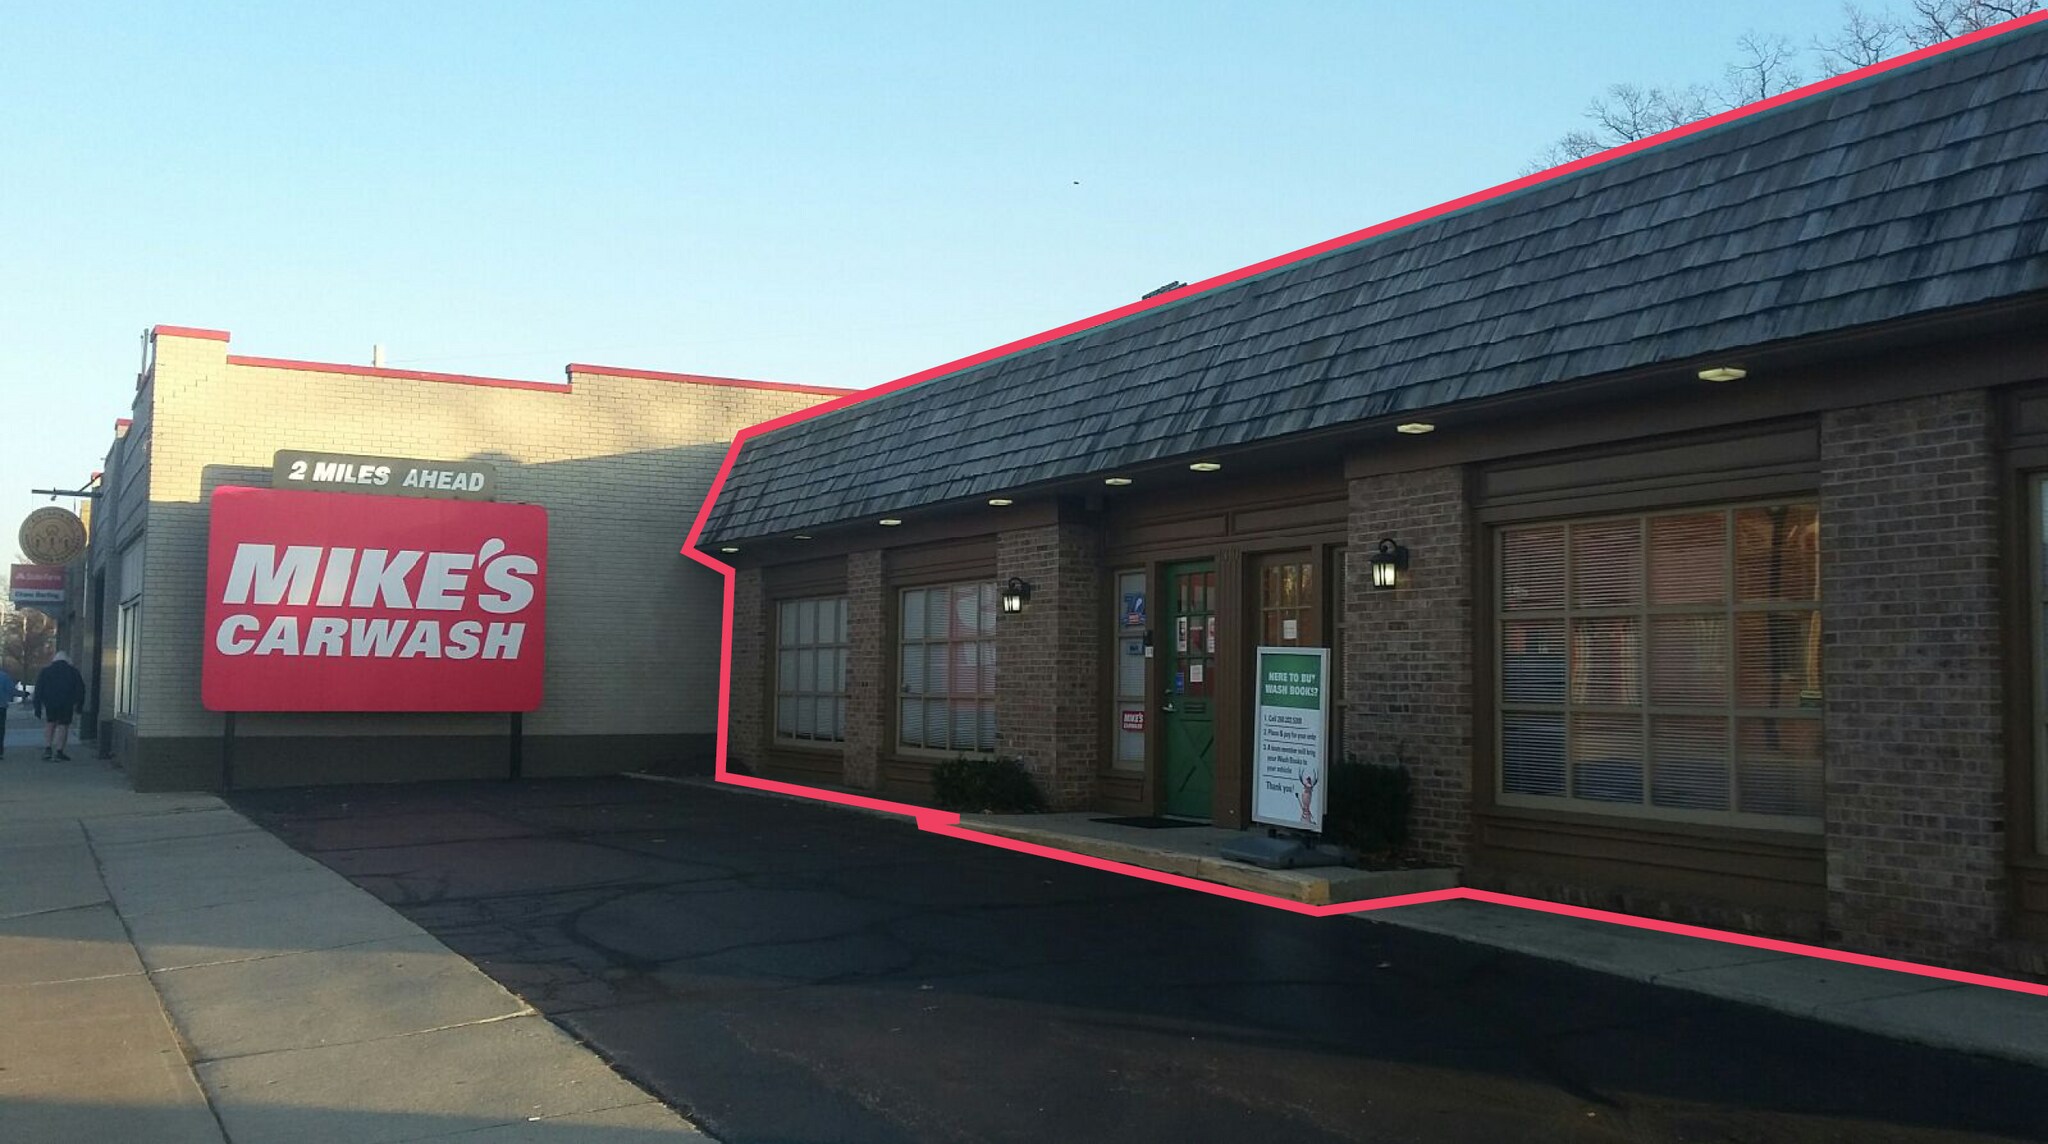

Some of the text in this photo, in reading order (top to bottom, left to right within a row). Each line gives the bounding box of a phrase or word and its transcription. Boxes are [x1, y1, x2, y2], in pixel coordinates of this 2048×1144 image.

[288, 460, 485, 492] 2 MILES AHEAD
[222, 537, 538, 615] MIKE'S
[215, 614, 526, 660] CARWASH
[1268, 672, 1316, 684] HERE TO BUY
[1265, 684, 1287, 695] WASH
[1266, 781, 1282, 791] Thank
